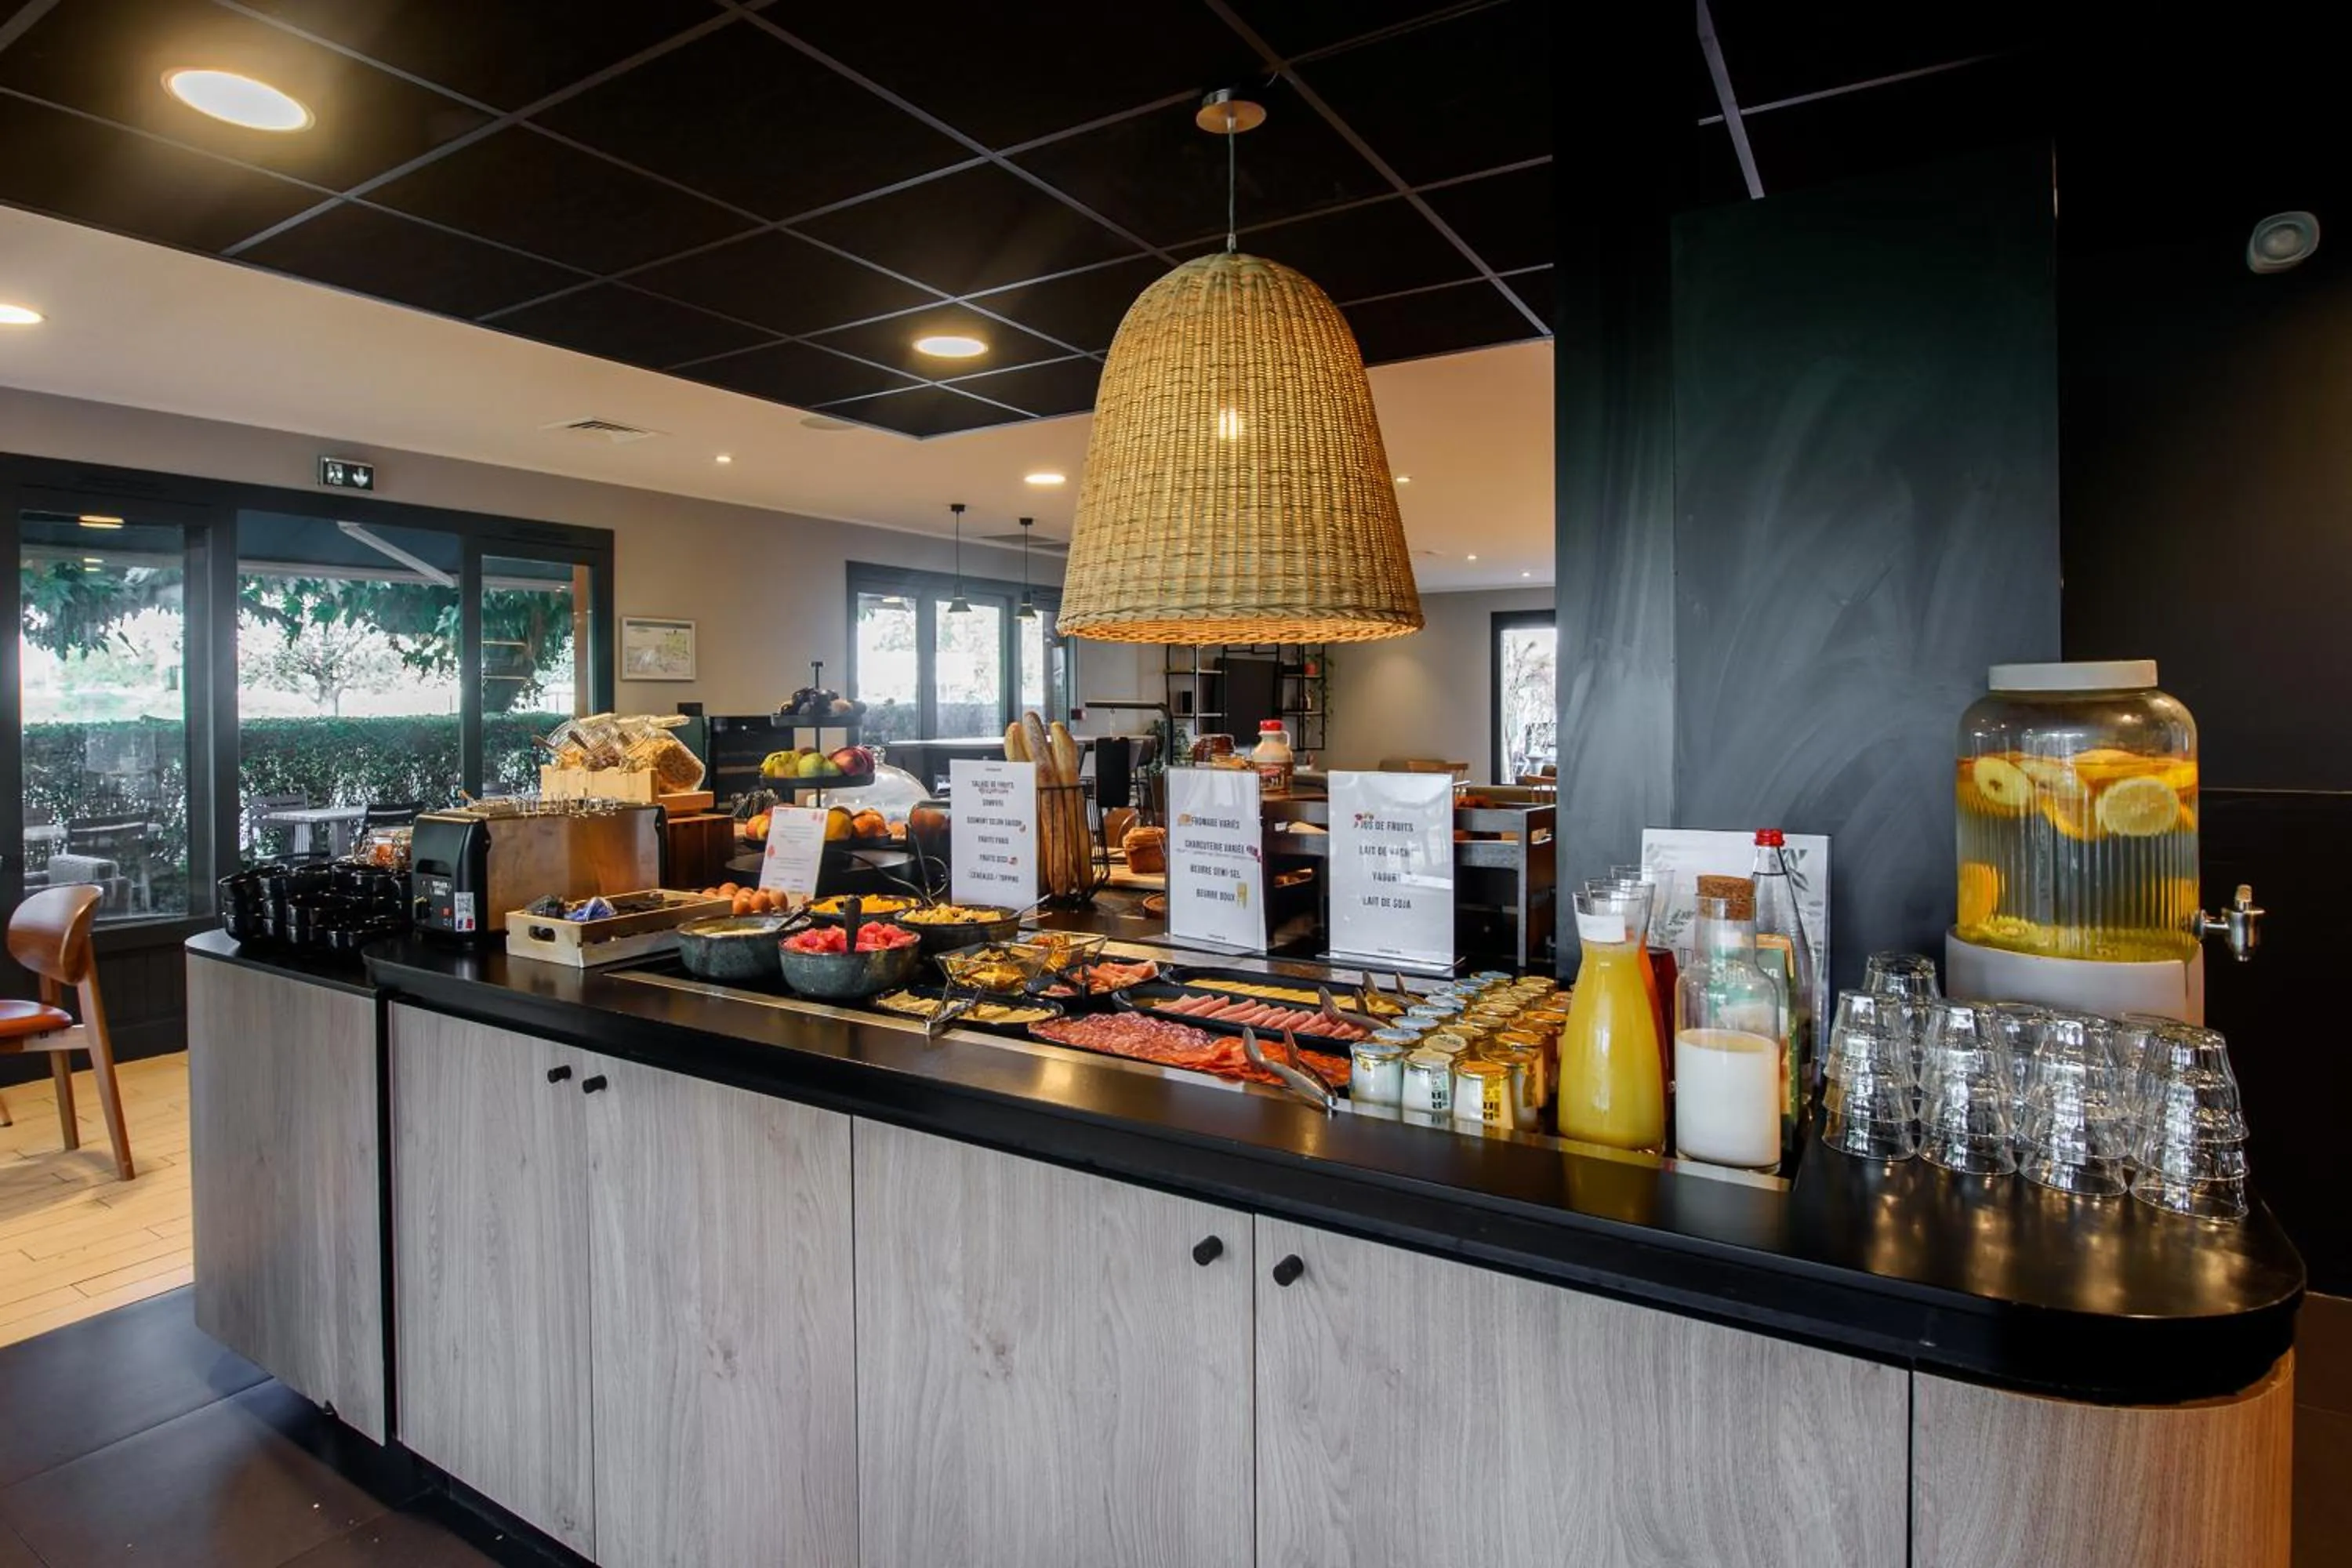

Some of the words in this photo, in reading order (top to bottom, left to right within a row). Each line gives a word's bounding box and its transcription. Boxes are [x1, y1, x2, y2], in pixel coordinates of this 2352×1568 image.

[1191, 816, 1218, 827] FROMAGE
[1375, 821, 1384, 831] DE
[1386, 821, 1414, 833] FRUITS
[1359, 845, 1377, 855] LAIT
[1377, 846, 1387, 857] DE
[1190, 864, 1211, 875] BEURRE
[1196, 888, 1218, 899] BEURRE
[1362, 896, 1379, 906] LAIT
[1380, 898, 1391, 907] DE
[1392, 898, 1412, 909] SOJA
